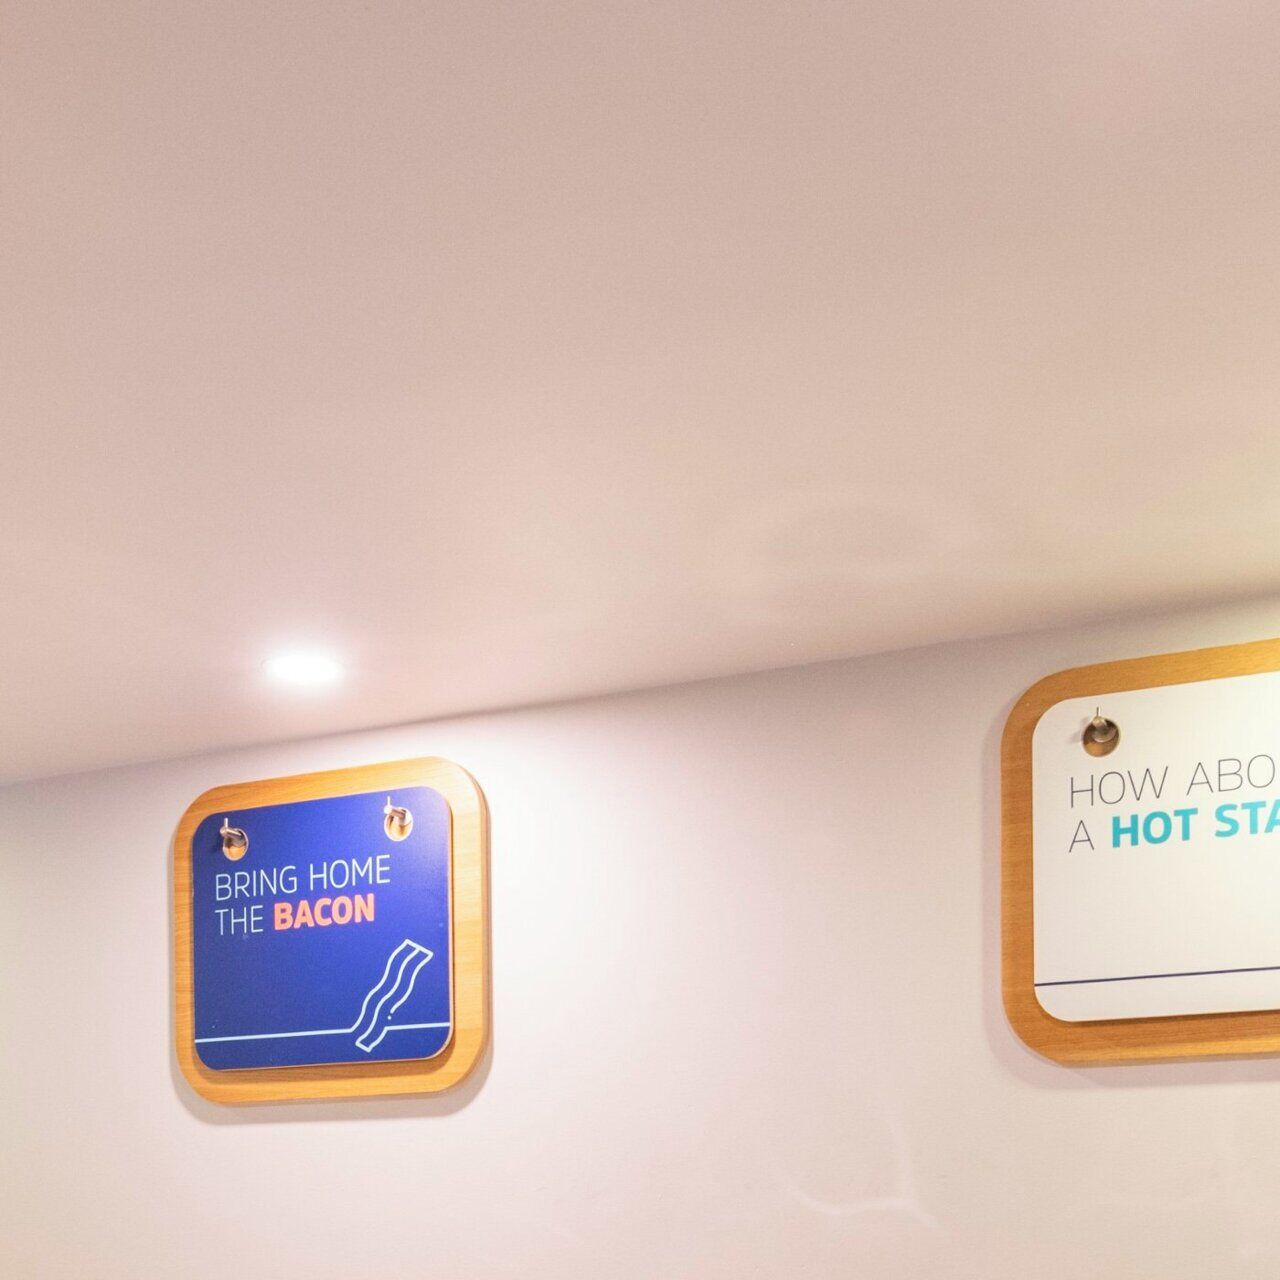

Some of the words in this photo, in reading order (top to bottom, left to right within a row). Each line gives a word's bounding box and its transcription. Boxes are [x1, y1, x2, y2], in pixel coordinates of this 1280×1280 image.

[1070, 765, 1168, 808] HOW
[1069, 819, 1095, 853] A
[1111, 807, 1198, 848] HOT
[215, 865, 298, 901] BRING
[309, 854, 391, 891] HOME
[215, 904, 263, 935] THE
[274, 893, 375, 931] BACON
